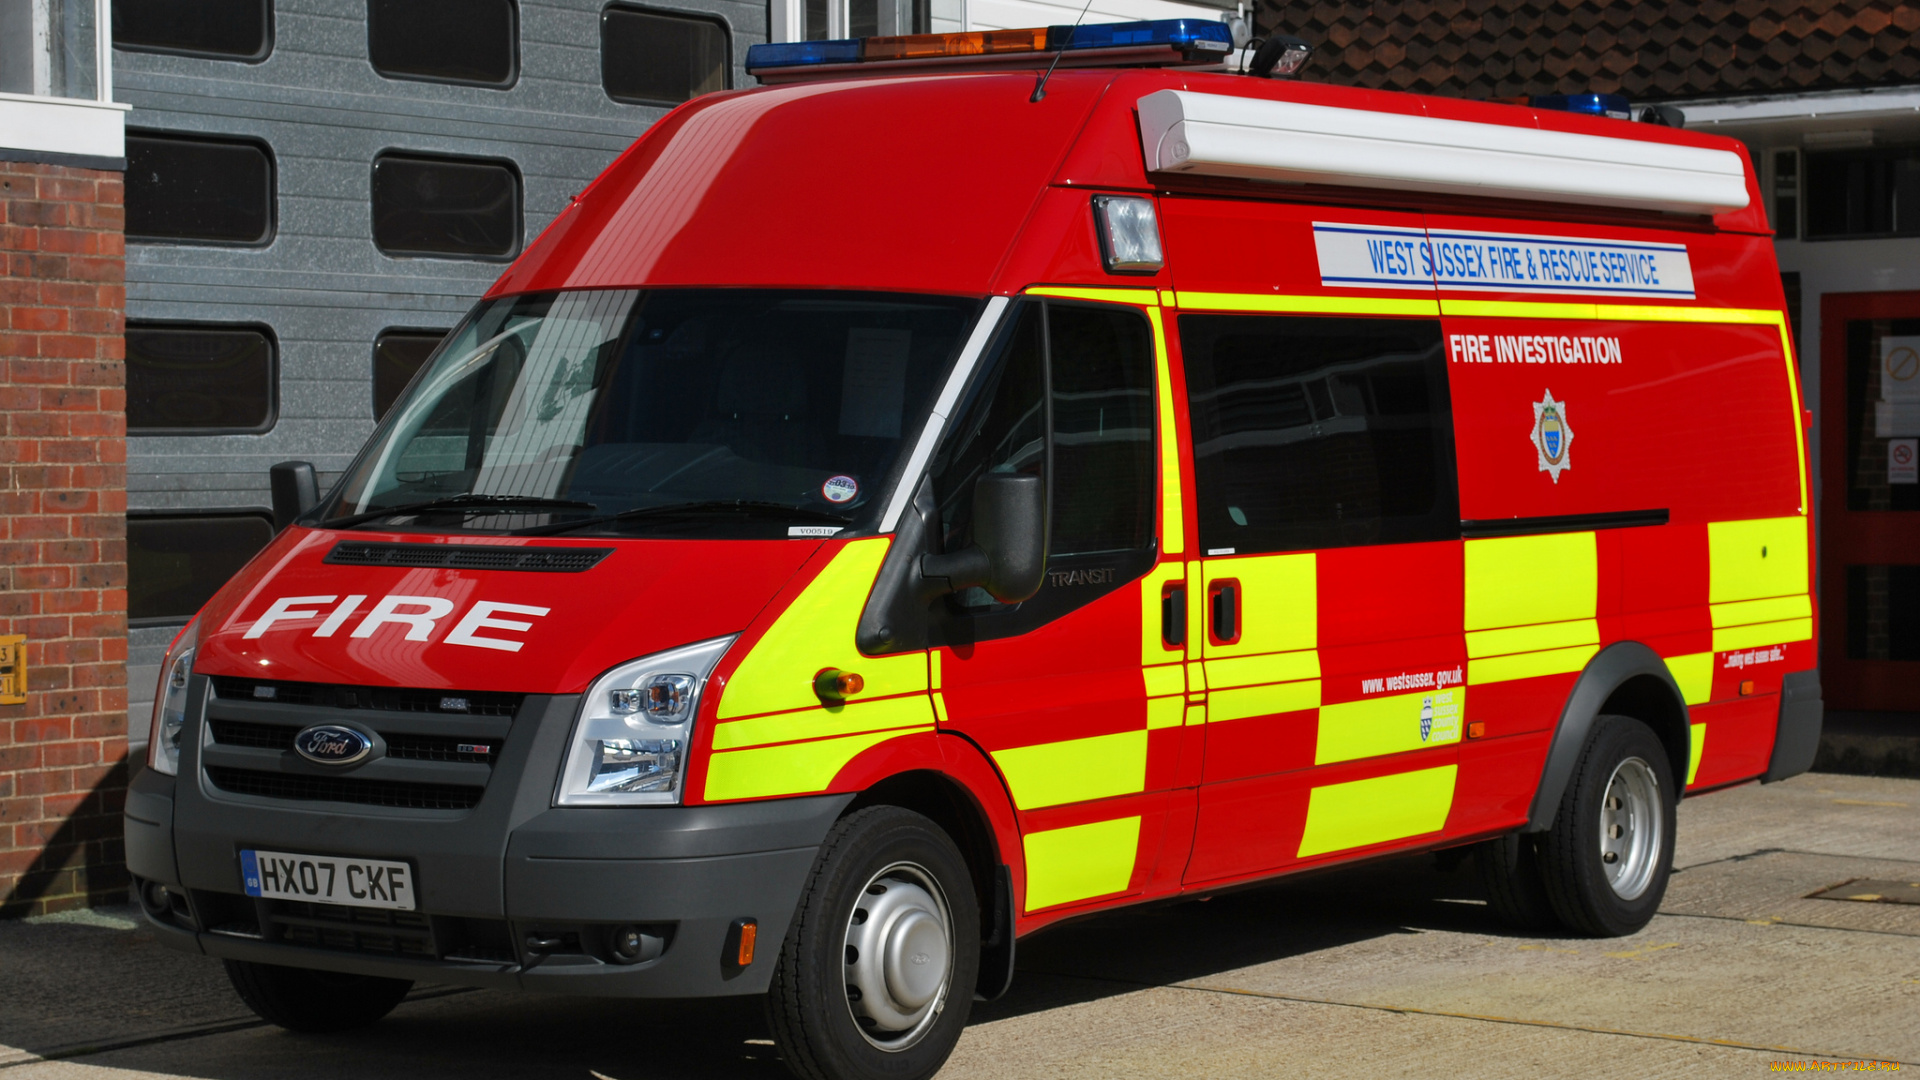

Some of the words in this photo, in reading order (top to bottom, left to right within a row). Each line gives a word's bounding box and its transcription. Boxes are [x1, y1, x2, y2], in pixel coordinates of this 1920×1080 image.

[1366, 239, 1415, 276] WEST
[1419, 241, 1487, 278] SUSSEX
[1488, 246, 1524, 280] FIRE
[1526, 248, 1537, 281] &
[1539, 248, 1601, 283] RESCUE
[1601, 251, 1660, 285] SERVICE
[1450, 334, 1493, 363] FIRE
[1494, 335, 1623, 364] INVESTIGATION
[1048, 567, 1116, 588] TRANSIT
[242, 594, 551, 652] FIRE
[1362, 678, 1385, 694] www.
[1386, 672, 1435, 691] westsussex.
[1437, 665, 1462, 690] gov.uk
[1435, 691, 1453, 704] west
[1433, 704, 1458, 717] sussex
[1433, 715, 1459, 729] county
[307, 730, 350, 755] Ford
[1432, 725, 1458, 742] council
[247, 877, 258, 888] GB
[259, 857, 336, 897] HX07
[346, 864, 405, 902] CKF
